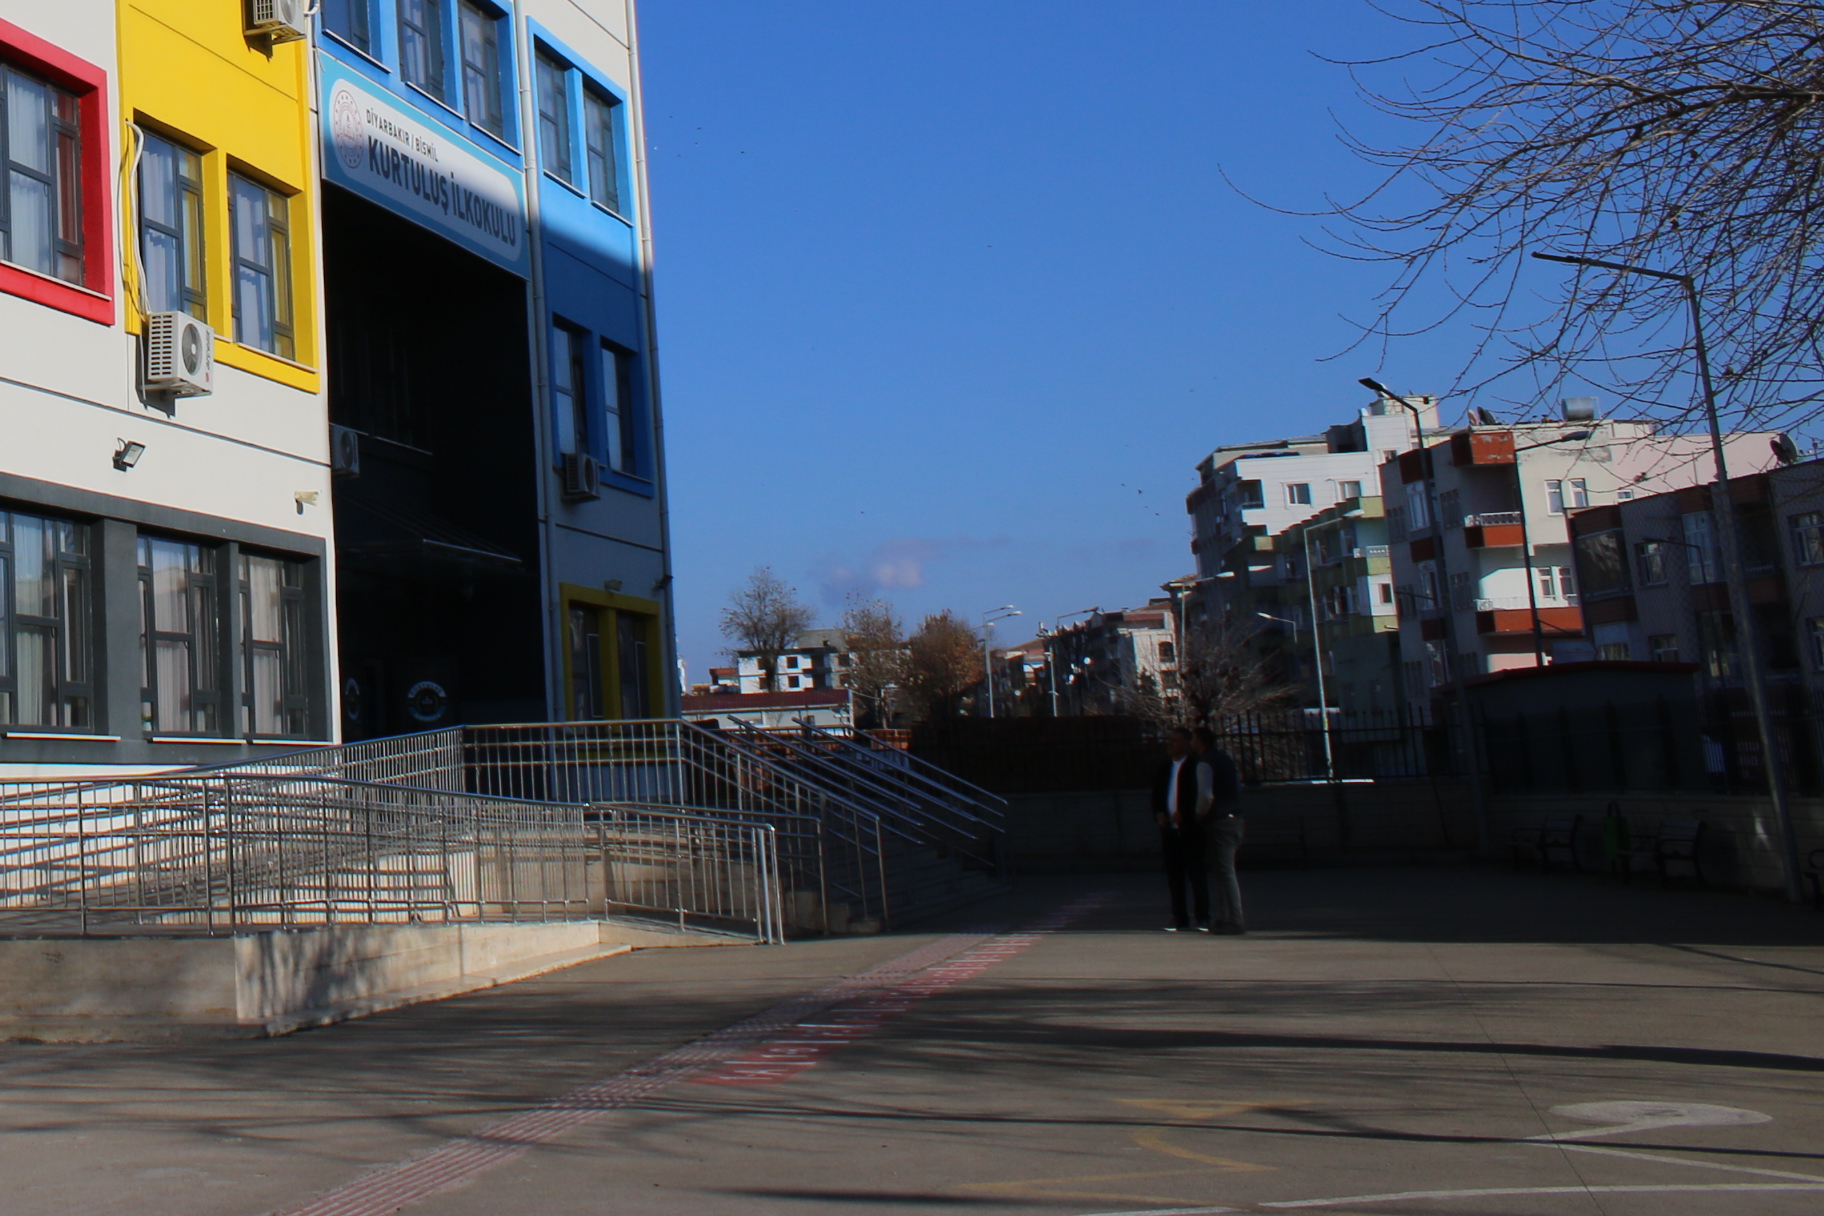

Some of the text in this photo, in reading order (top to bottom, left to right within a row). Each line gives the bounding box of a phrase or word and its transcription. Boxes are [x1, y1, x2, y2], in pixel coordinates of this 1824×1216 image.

[366, 108, 410, 147] DİYARBAKIR
[416, 136, 439, 163] BİSMİL
[368, 135, 516, 247] KURTULUŞ İLKOKULU
